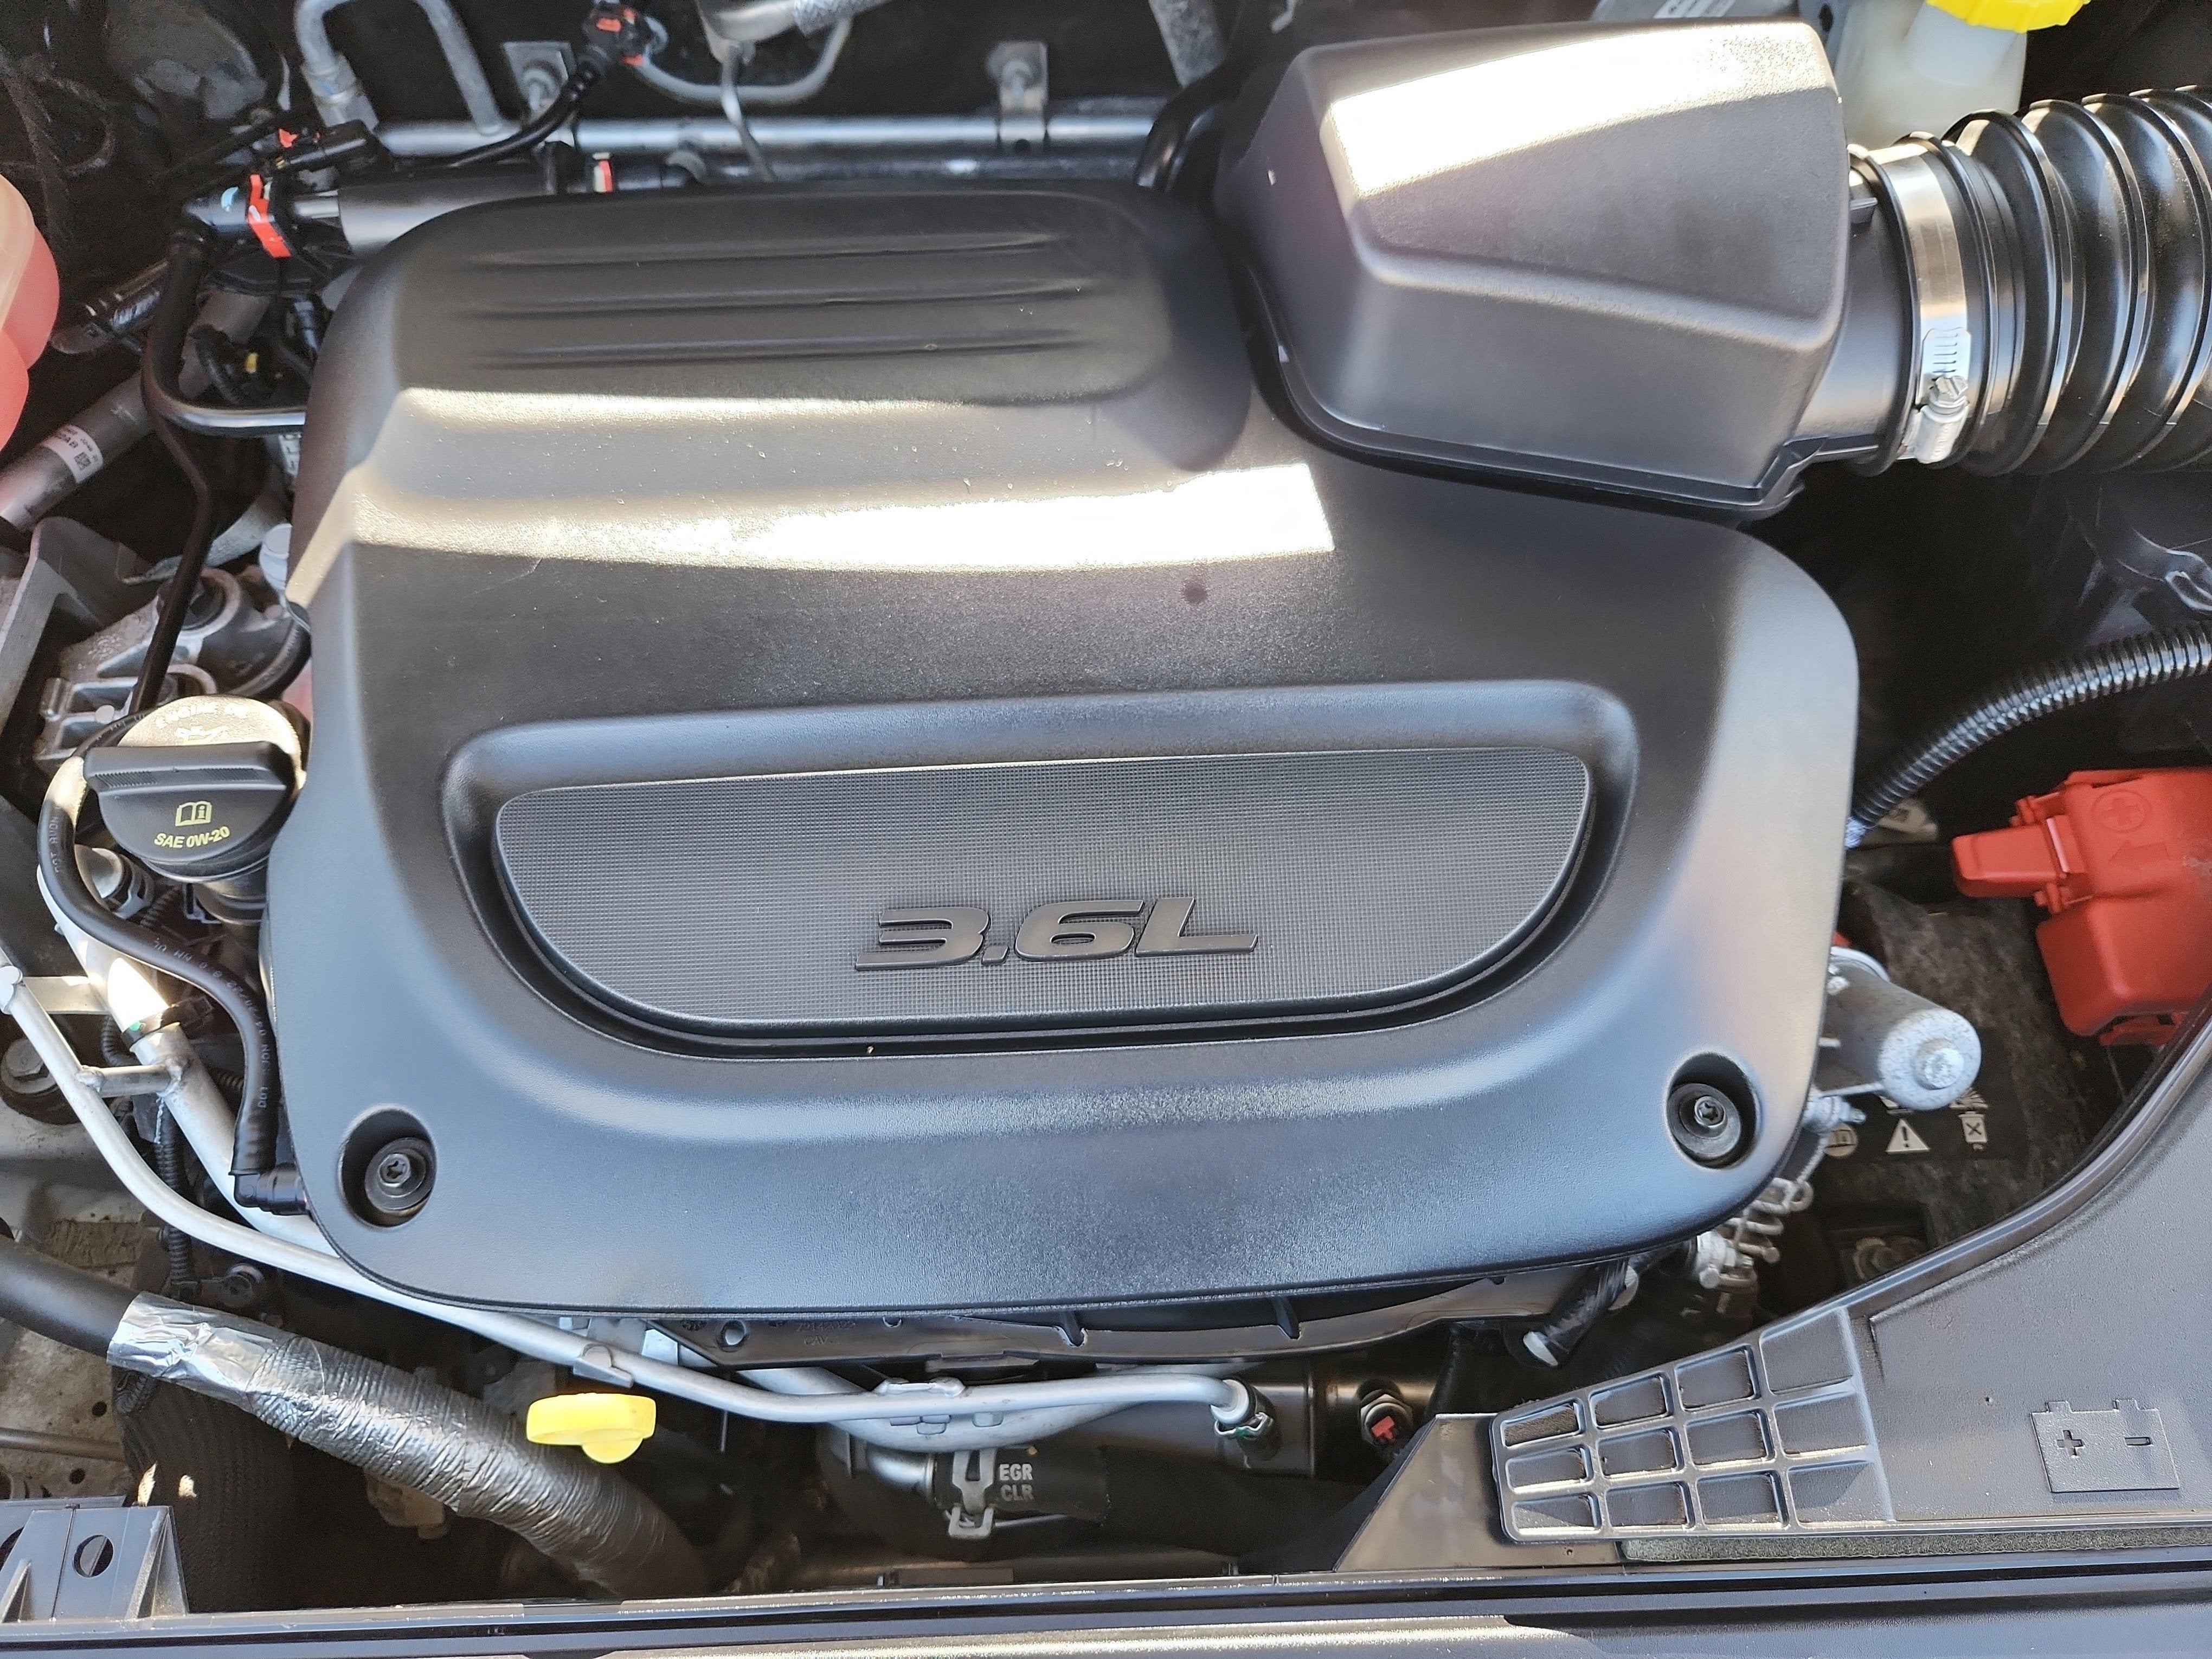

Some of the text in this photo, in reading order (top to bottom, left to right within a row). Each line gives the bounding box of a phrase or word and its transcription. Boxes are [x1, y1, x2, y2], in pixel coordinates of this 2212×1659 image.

[154, 826, 230, 848] SAE 0W-20
[855, 896, 1258, 971] 3.6L
[999, 1464, 1033, 1481] EGR
[1000, 1484, 1034, 1501] CLR
